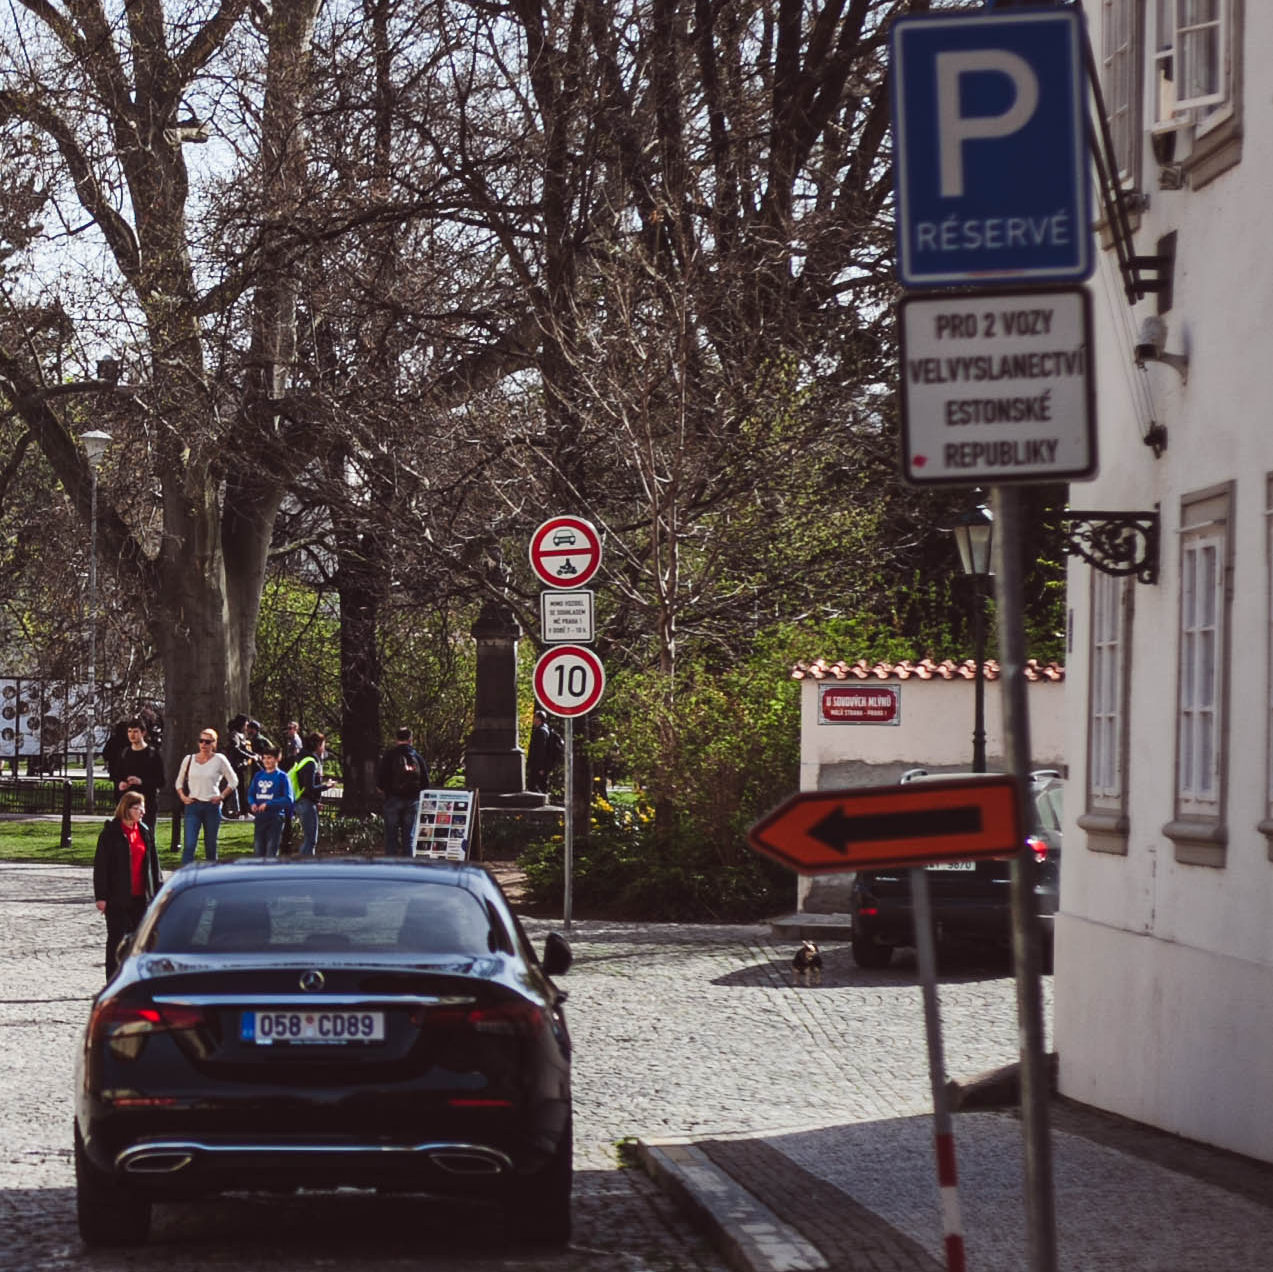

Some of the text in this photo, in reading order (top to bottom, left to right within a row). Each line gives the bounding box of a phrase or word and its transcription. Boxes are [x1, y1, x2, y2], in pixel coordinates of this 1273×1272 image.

[936, 48, 1039, 198] P
[916, 209, 1070, 253] RÉSERVÉ
[935, 309, 1054, 340] PRO 2 VOZY
[908, 345, 1086, 385] VELVYSLANECTVÍ
[945, 388, 1052, 427] ESTONSKÉ
[943, 439, 1059, 469] REPUBLIKY
[555, 664, 587, 698] 10
[826, 694, 892, 707] U SOVOVÝCH MLÝNŮ
[260, 1014, 374, 1037] 058 CD89
